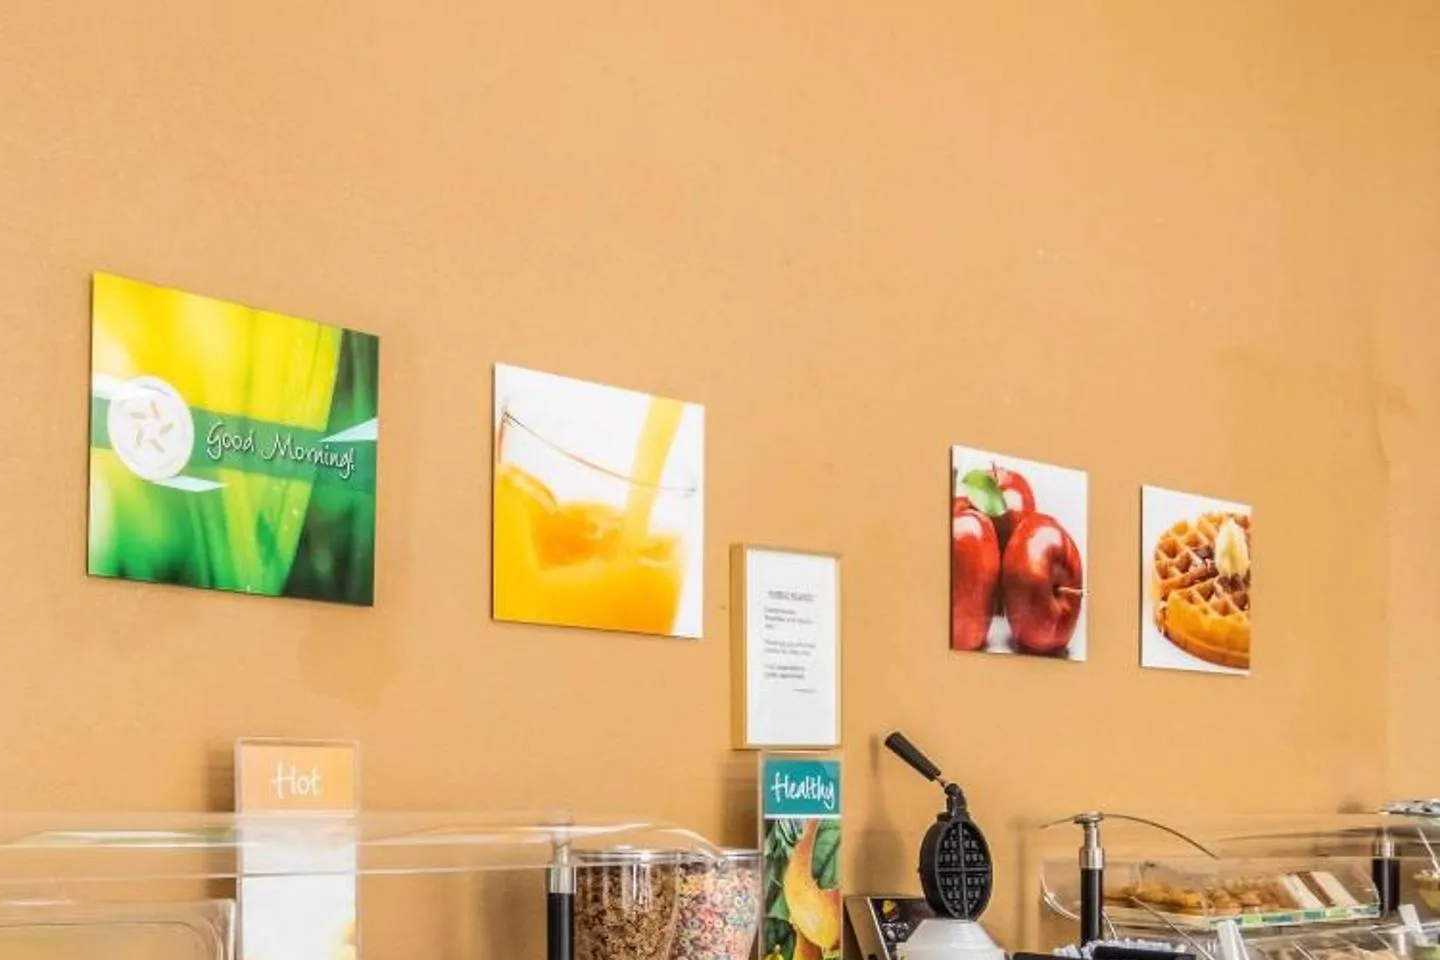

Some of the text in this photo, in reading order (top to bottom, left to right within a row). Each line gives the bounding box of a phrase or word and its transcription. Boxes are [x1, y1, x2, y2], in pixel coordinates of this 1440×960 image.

[205, 418, 357, 480] Good Morning!
[271, 761, 322, 800] Hot
[771, 771, 835, 810] Healthy
